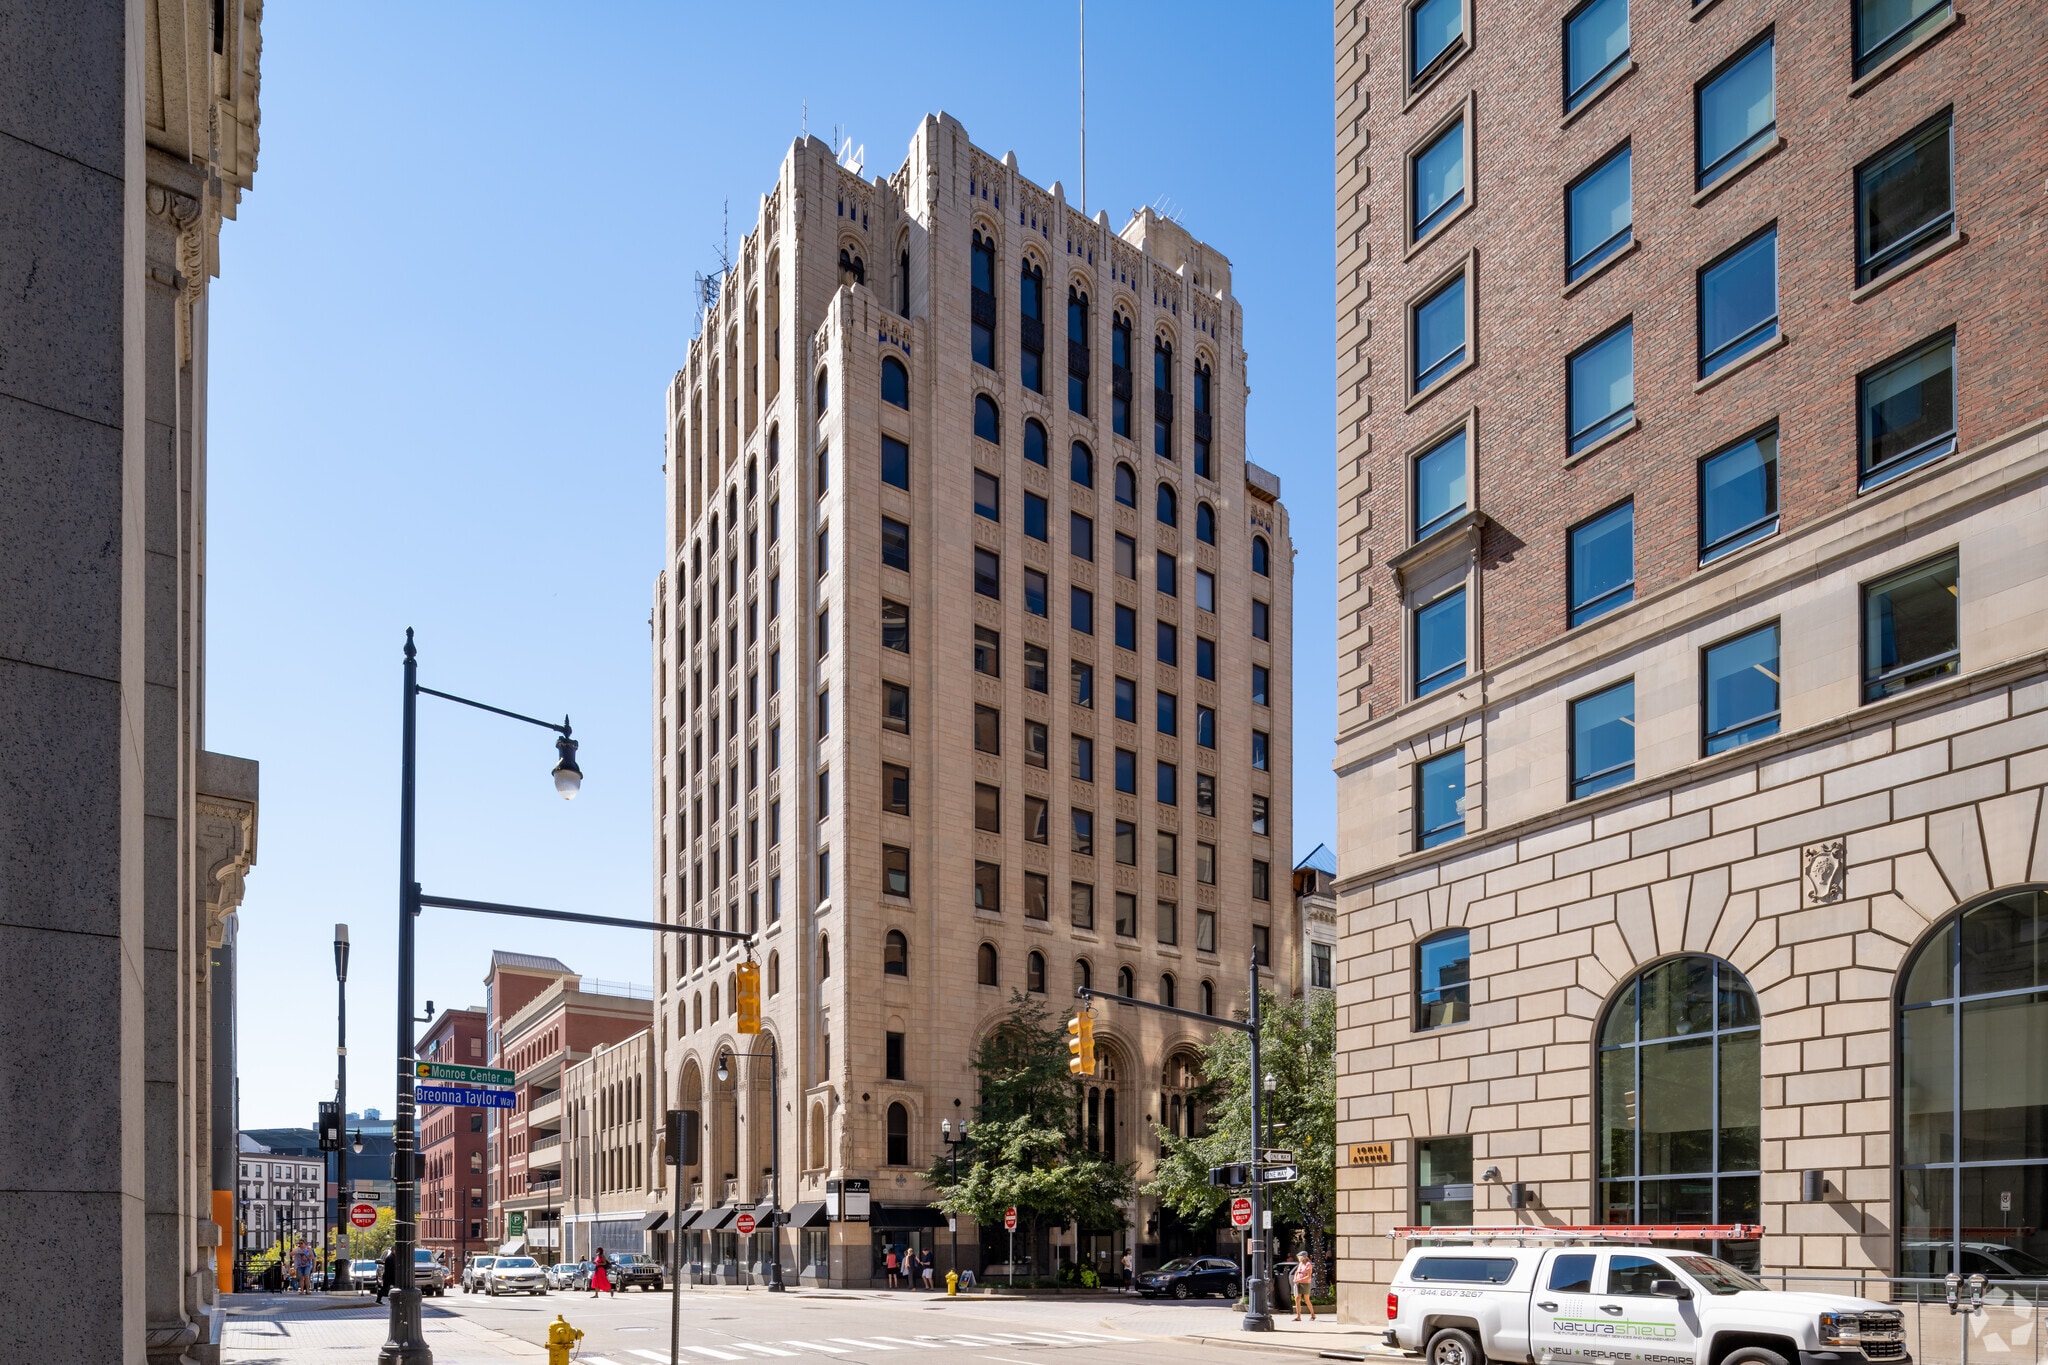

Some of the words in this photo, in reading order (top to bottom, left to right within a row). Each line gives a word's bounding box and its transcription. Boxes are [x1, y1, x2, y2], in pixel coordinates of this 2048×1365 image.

[431, 1065, 466, 1079] Monroe
[470, 1069, 500, 1083] Center
[416, 1088, 462, 1103] Breonna
[465, 1091, 497, 1107] Taylor
[500, 1097, 515, 1108] Way
[1357, 1146, 1384, 1155] IONIA
[1353, 1155, 1388, 1164] AVENUE
[1265, 1170, 1276, 1179] ONE
[1277, 1169, 1287, 1177] WAY
[514, 1216, 521, 1224] P
[1548, 1347, 1572, 1355] NEW
[1583, 1349, 1632, 1361] REPLACE
[1644, 1354, 1694, 1365] REPAIRS
